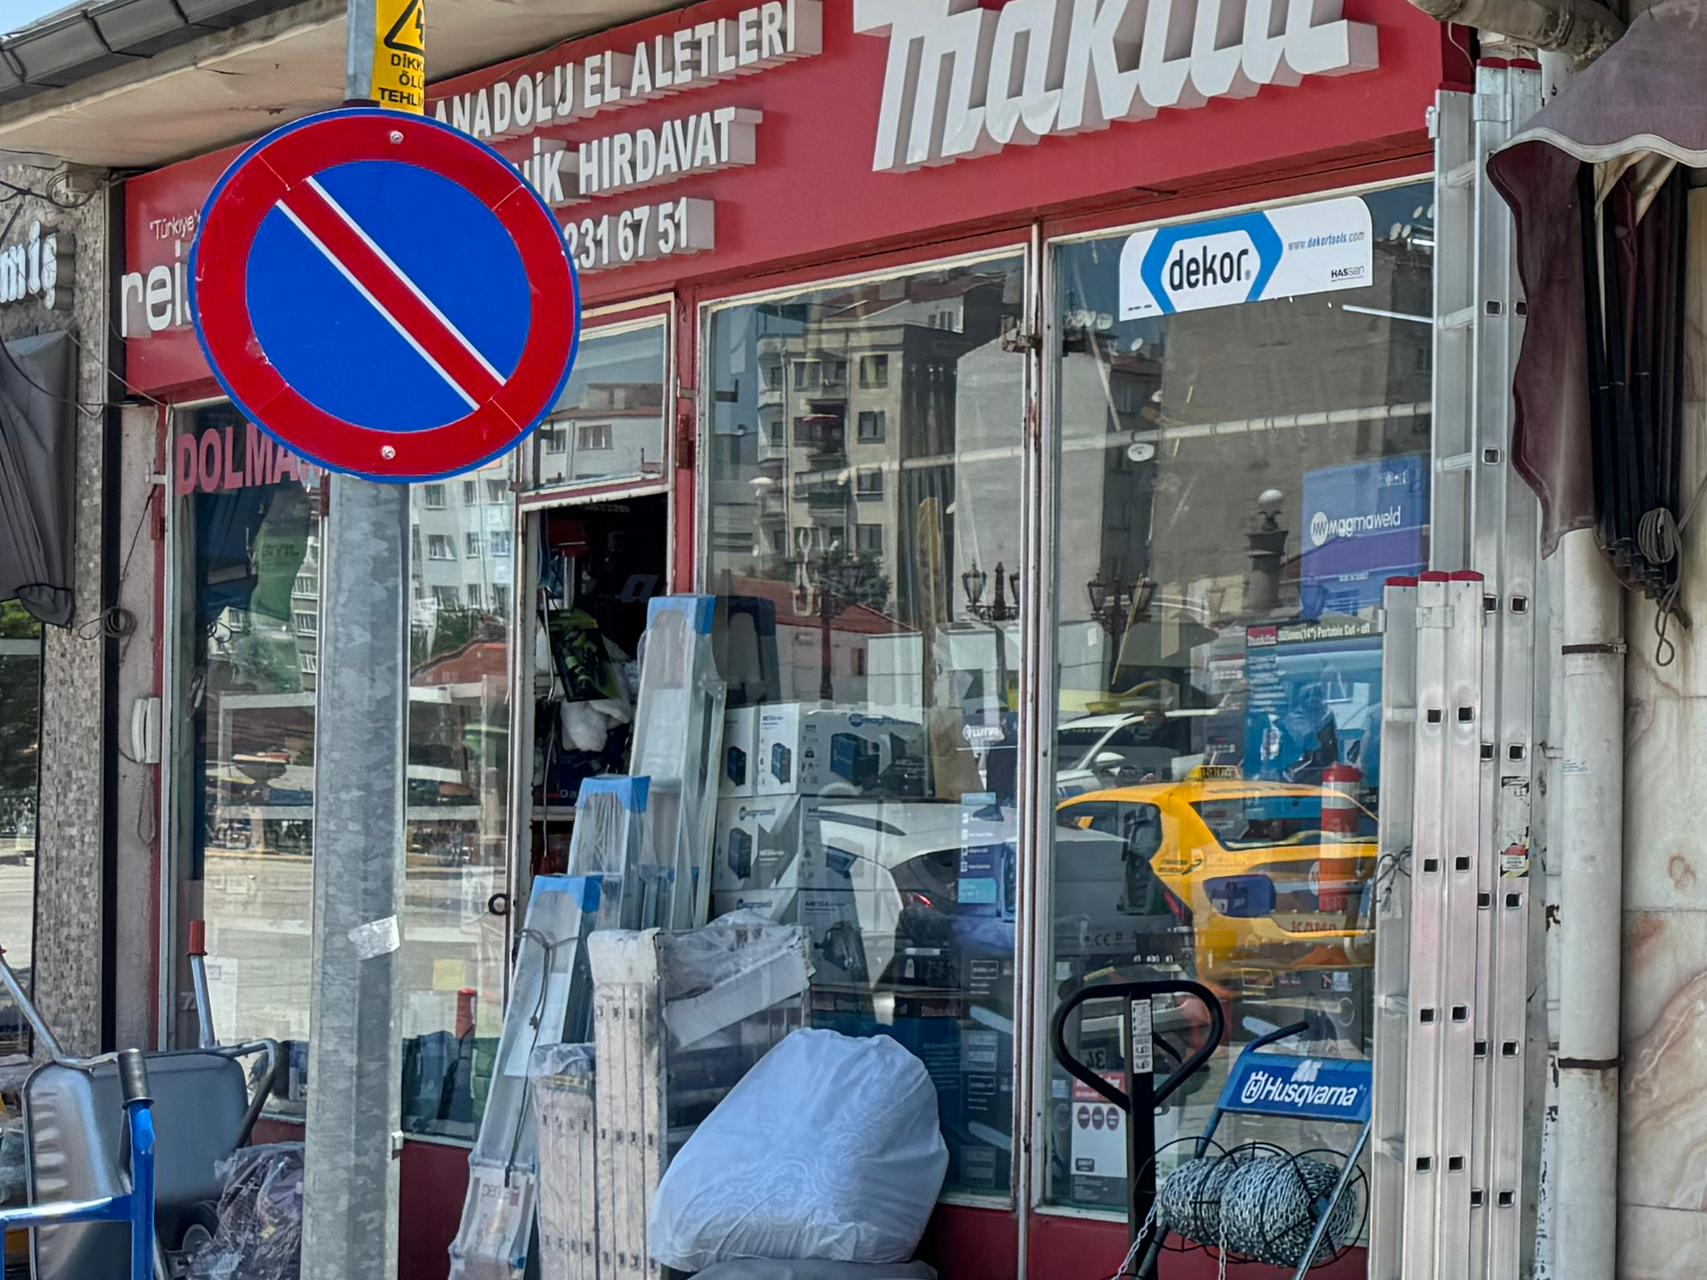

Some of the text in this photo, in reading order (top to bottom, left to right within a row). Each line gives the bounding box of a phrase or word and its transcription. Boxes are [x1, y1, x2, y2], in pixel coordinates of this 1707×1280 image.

[583, 50, 621, 110] EL
[578, 106, 736, 196] HIRDAVAT
[616, 205, 651, 262] 67
[657, 196, 688, 255] 51
[121, 239, 193, 338] rei
[1169, 245, 1249, 291] dekor
[1260, 1076, 1359, 1108] Husqvarna
